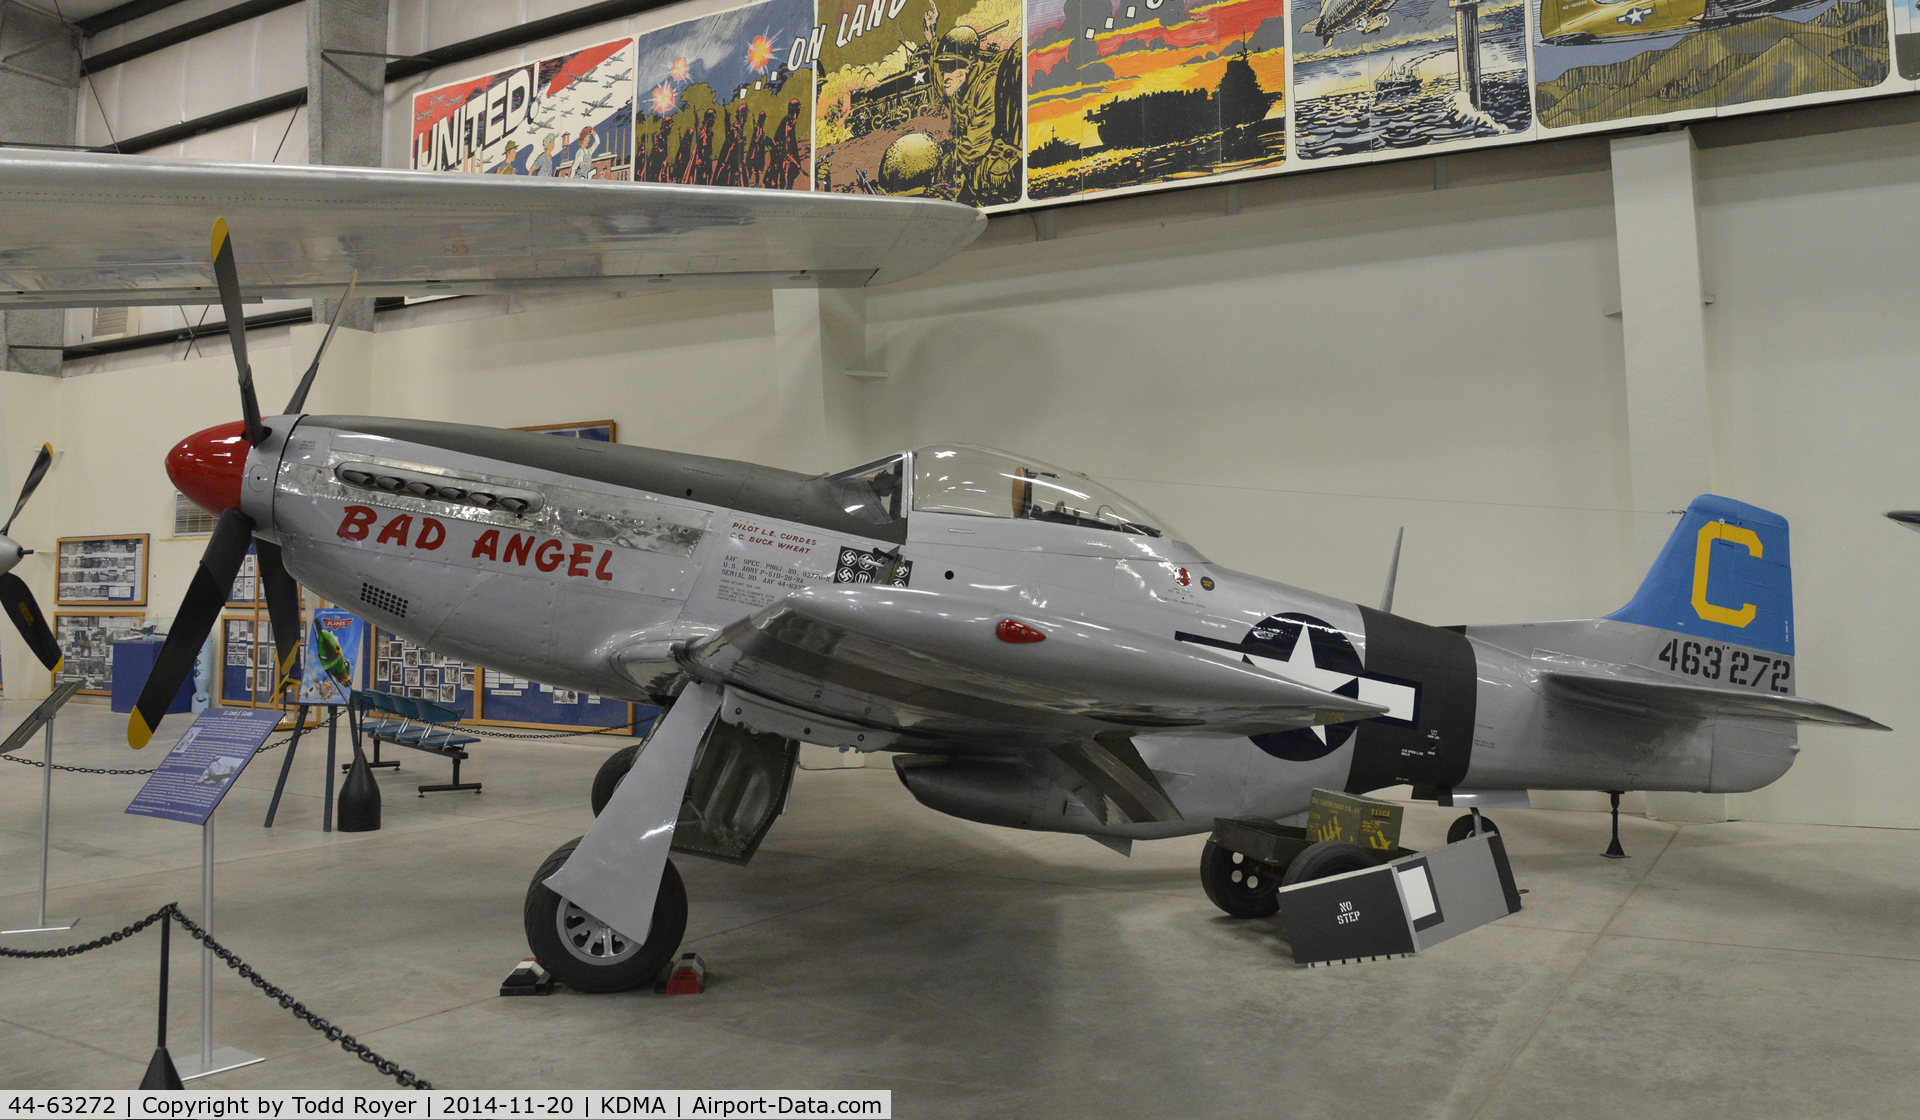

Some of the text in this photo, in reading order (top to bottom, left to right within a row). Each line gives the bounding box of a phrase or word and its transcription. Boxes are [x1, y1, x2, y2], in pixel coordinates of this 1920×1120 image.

[787, 23, 827, 71] ON
[415, 61, 540, 171] UNITED!
[336, 505, 614, 582] BAD ANGEL
[732, 522, 817, 546] PILOT L.E. CURDES
[749, 536, 774, 546] BUCK
[777, 542, 811, 554] WHEAT
[722, 568, 746, 580] SERIAL
[742, 565, 758, 575] ARMY
[1690, 520, 1763, 628] C
[1336, 910, 1360, 924] STEP
[1339, 901, 1352, 912] NO
